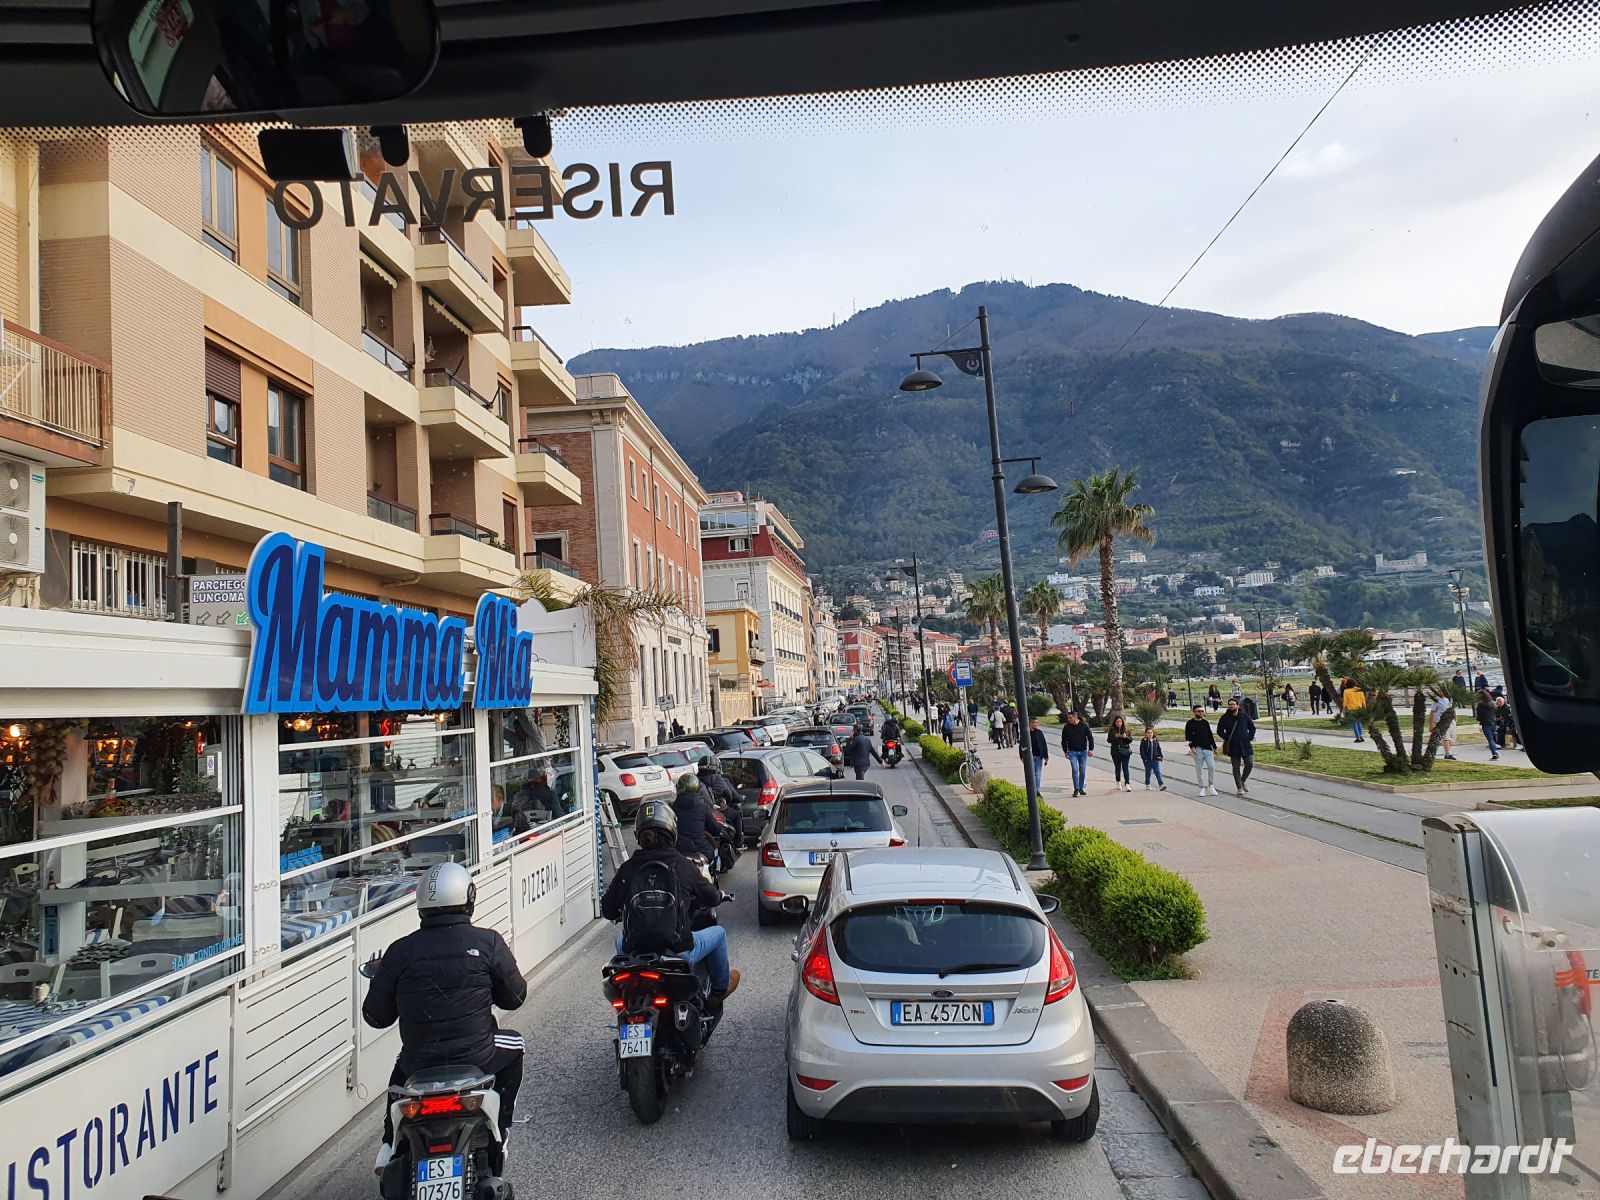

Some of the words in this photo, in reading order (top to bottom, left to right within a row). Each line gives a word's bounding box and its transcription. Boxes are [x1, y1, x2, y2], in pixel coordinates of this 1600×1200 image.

[250, 540, 464, 704] Mamma
[475, 598, 533, 704] Mia
[521, 860, 559, 908] PIZZERIA
[903, 1004, 923, 1022] EA
[930, 1004, 982, 1022] 457CN
[628, 1025, 640, 1038] ES
[622, 1040, 649, 1055] 76411
[429, 1160, 445, 1179] ES
[419, 1181, 460, 1200] 07376
